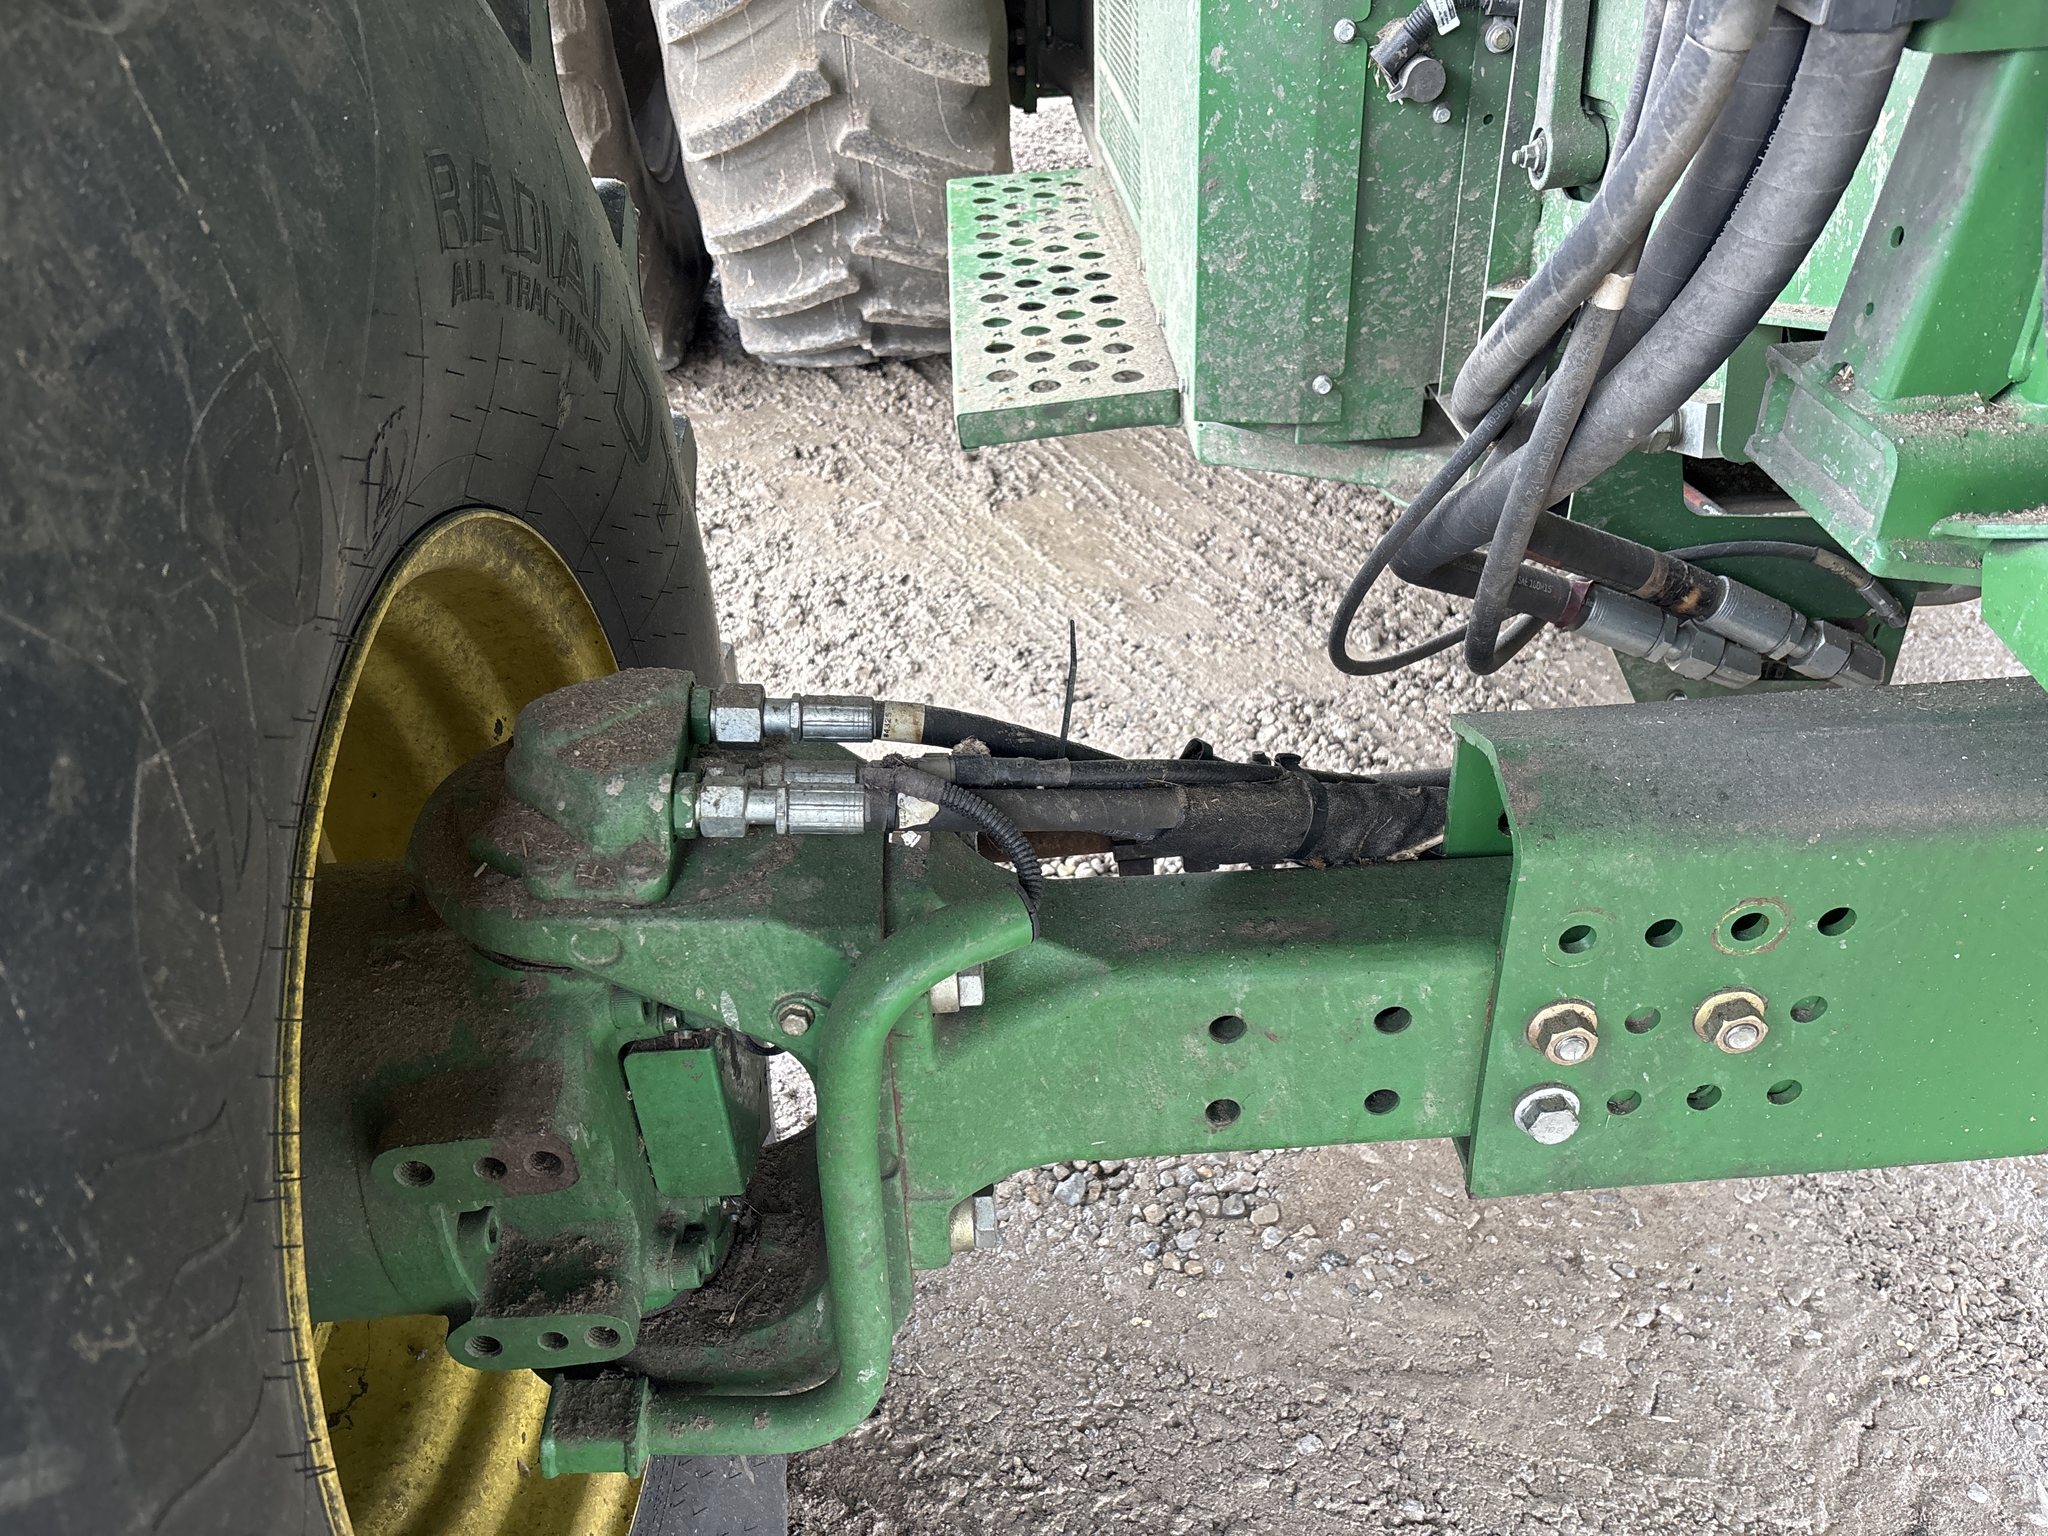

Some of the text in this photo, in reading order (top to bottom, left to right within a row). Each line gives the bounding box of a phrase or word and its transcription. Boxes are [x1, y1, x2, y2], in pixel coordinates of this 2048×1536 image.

[424, 149, 611, 354] RADIAL
[451, 260, 604, 382] ALL TRACTION
[1516, 575, 1529, 586] SAE
